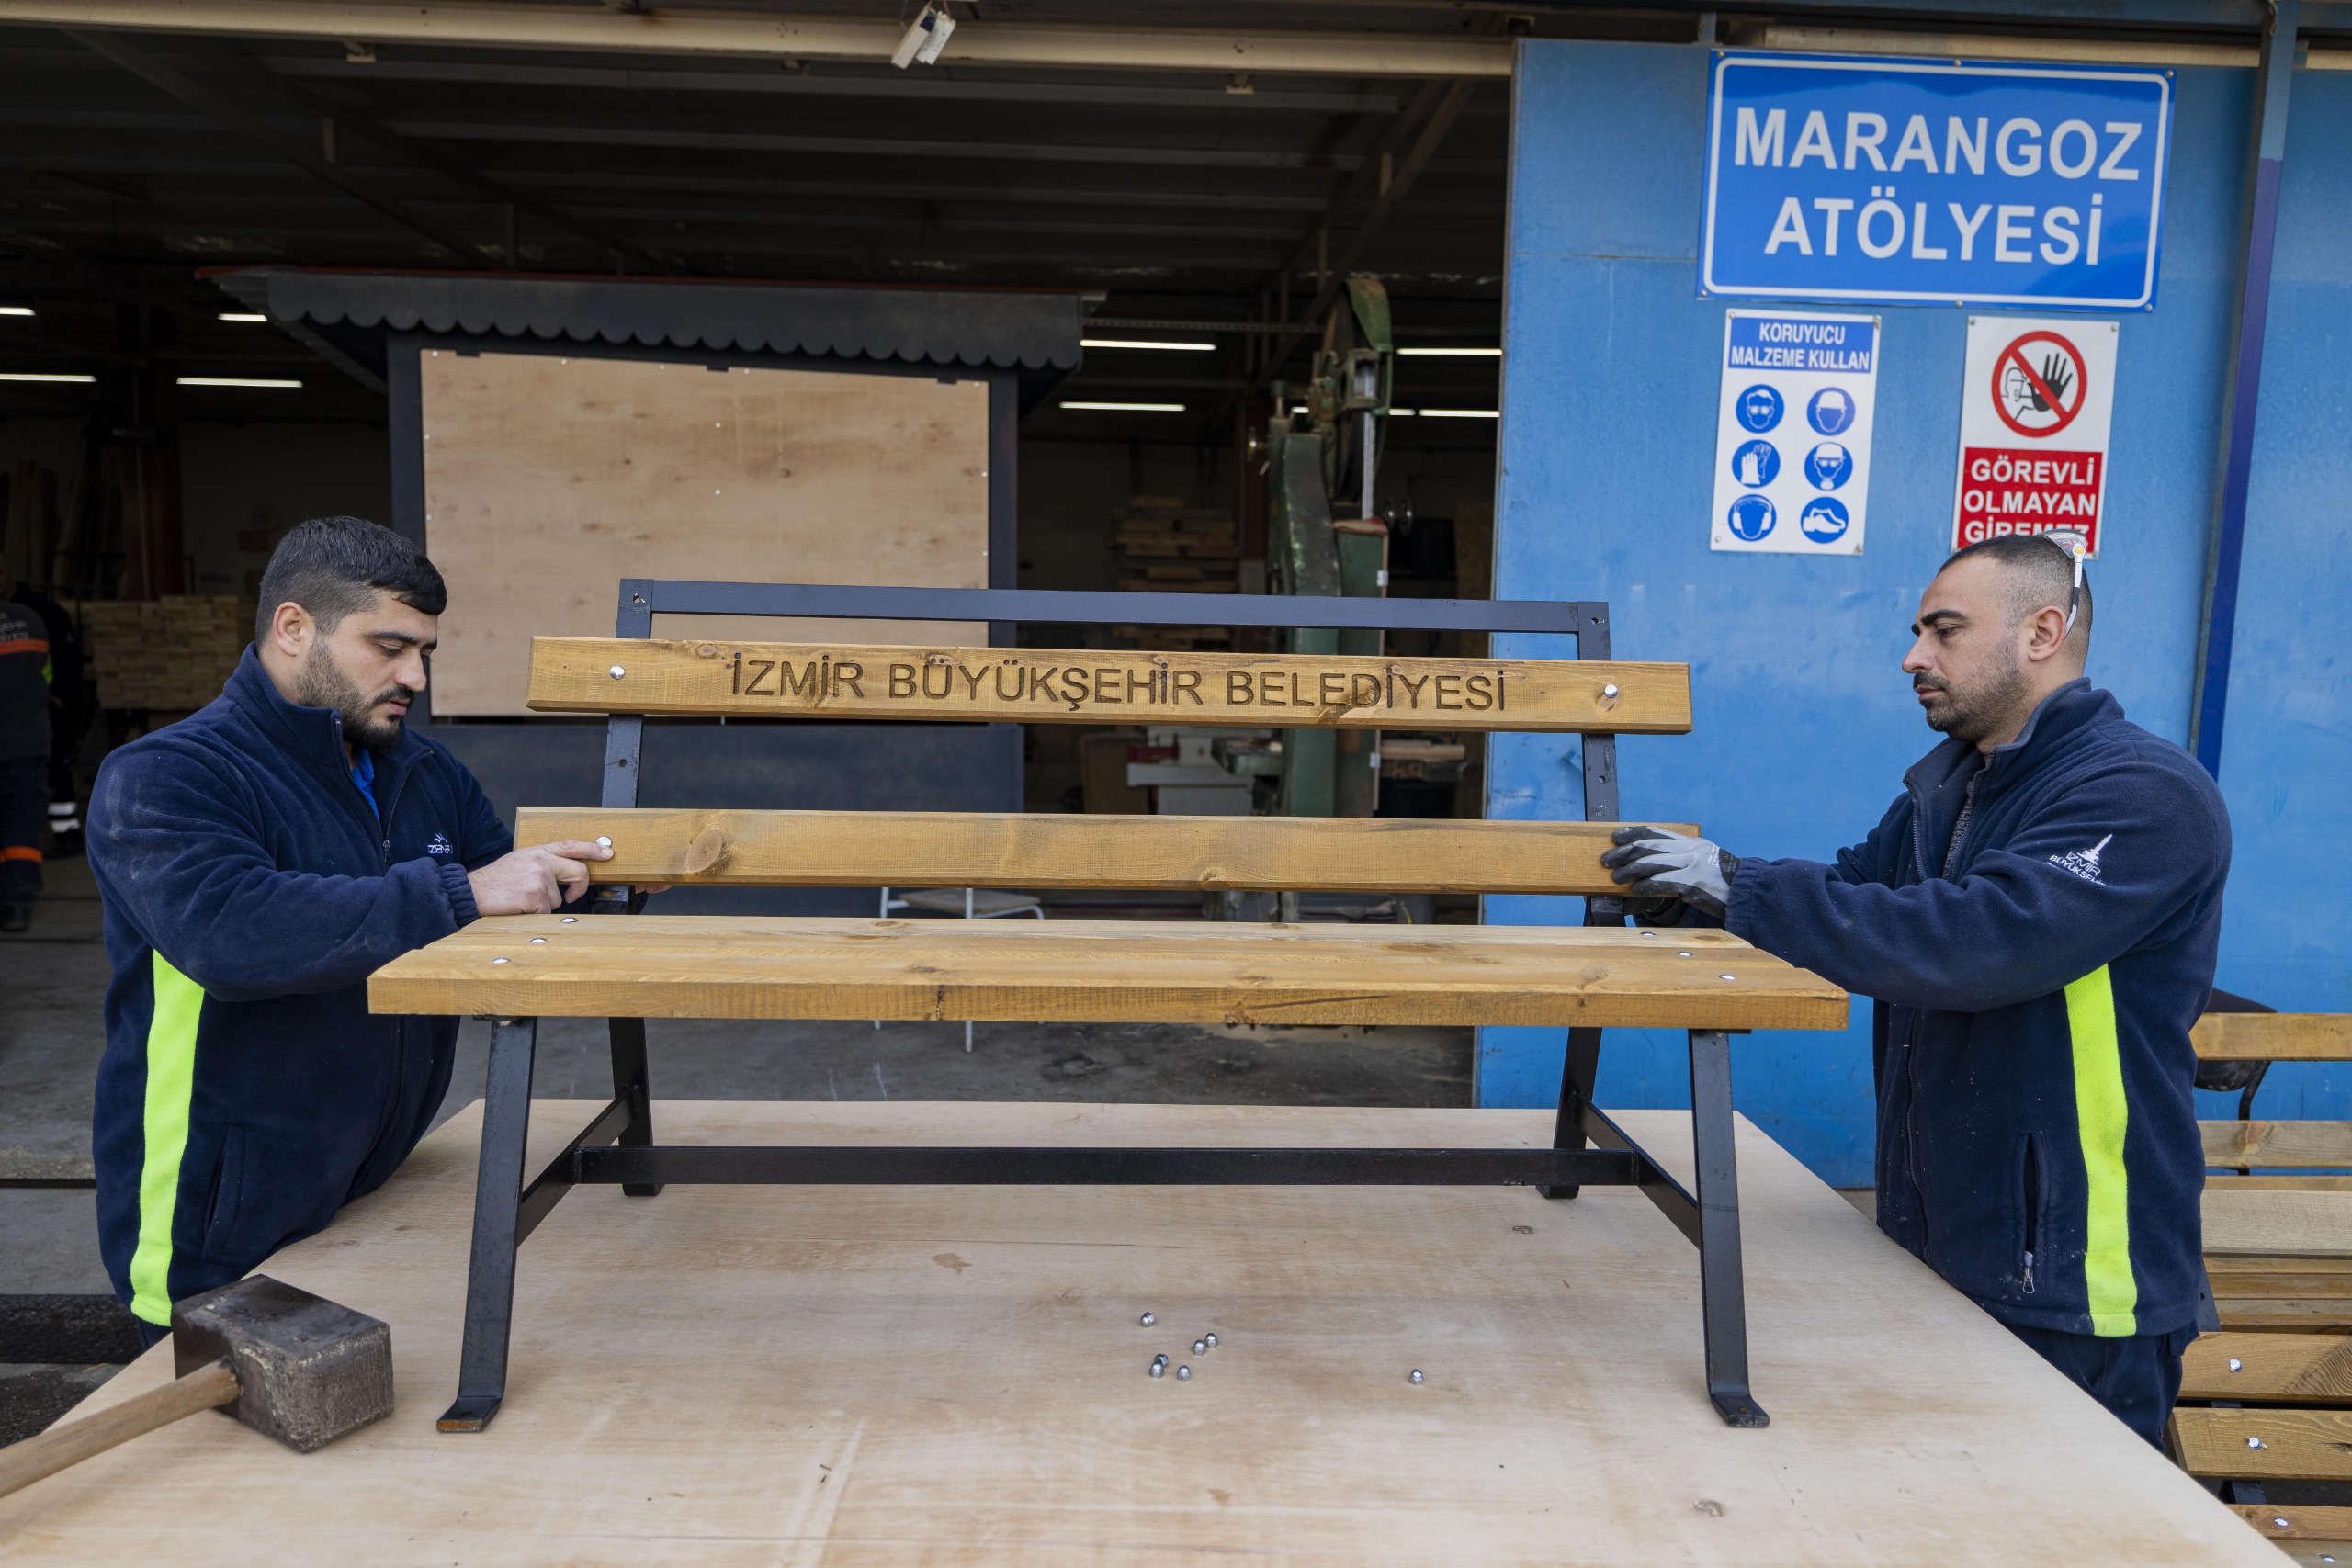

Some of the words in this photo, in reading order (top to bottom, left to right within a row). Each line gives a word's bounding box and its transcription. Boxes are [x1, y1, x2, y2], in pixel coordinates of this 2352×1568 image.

[1734, 107, 2143, 182] MARANGOZ
[1763, 185, 2104, 266] ATÖLYESİ
[1758, 321, 1847, 344] KORUYUCU
[1731, 345, 1805, 367] MALZEME
[1808, 349, 1871, 370] KULLAN
[1971, 455, 2095, 486] GÖREVLİ
[1963, 489, 2097, 517] OLMAYAN
[1964, 515, 2090, 545] GİRE
[731, 651, 865, 700] İZMİR
[888, 654, 1204, 712] BÜYÜKŞEHİR
[1227, 666, 1506, 712] BELEDİYESİ
